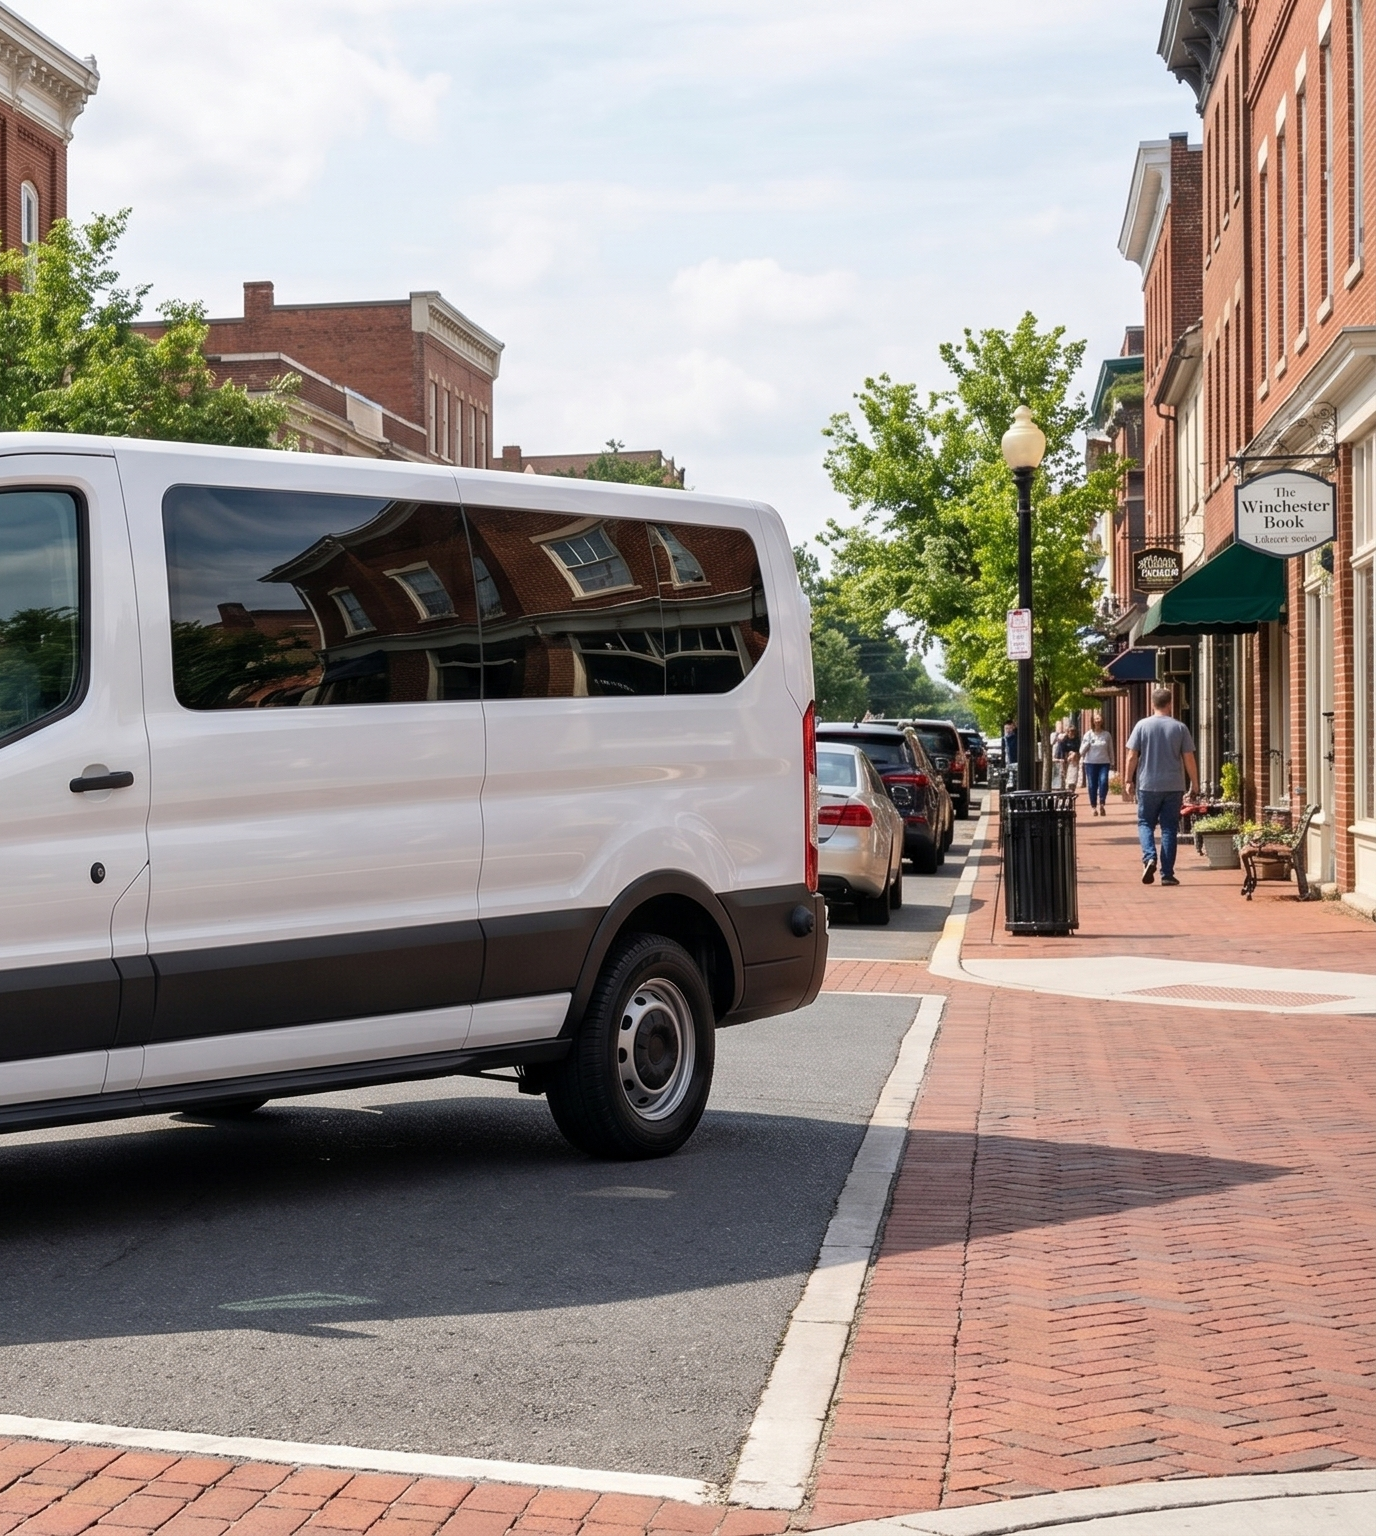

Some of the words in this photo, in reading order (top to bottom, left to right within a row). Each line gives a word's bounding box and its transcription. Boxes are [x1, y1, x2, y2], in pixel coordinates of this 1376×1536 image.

[1274, 487, 1296, 498] The
[1241, 499, 1330, 514] Winchester
[1264, 515, 1305, 529] Book
